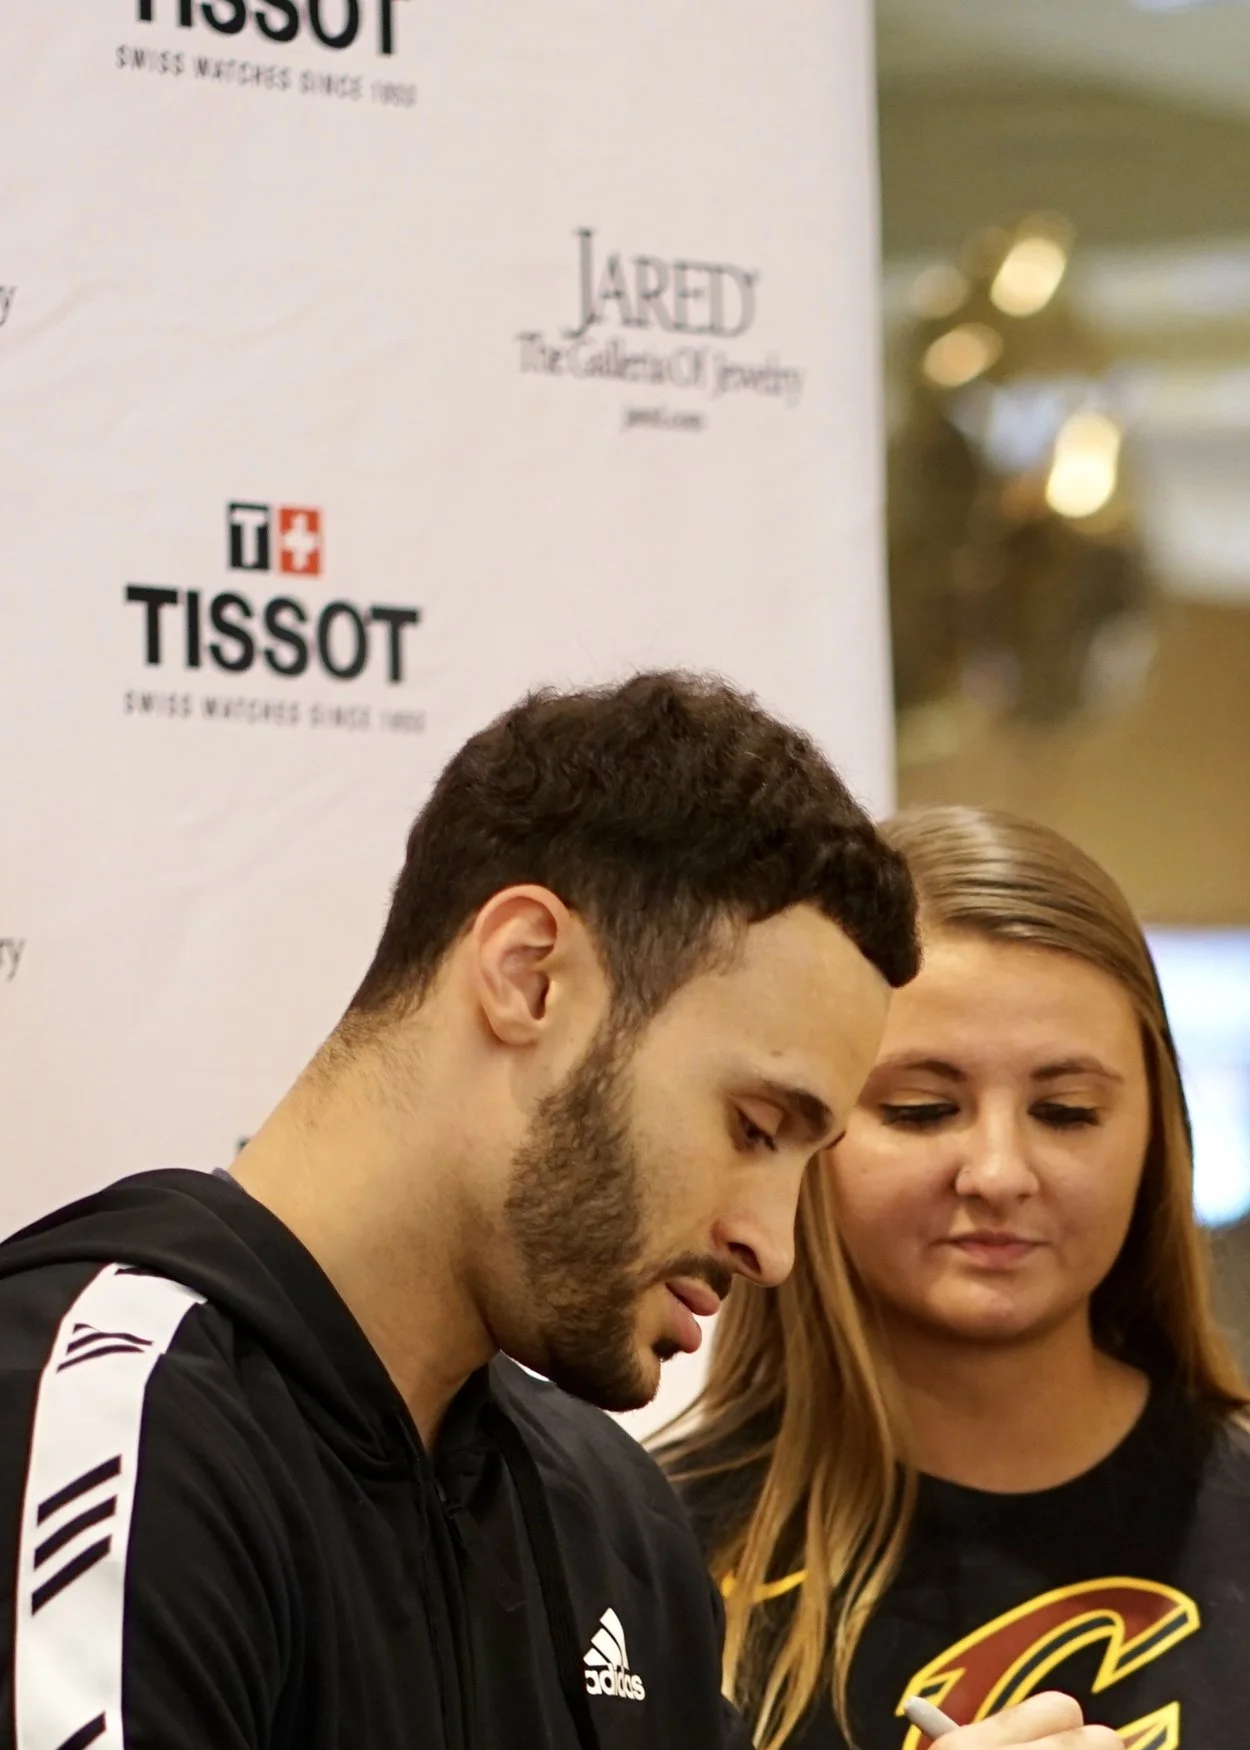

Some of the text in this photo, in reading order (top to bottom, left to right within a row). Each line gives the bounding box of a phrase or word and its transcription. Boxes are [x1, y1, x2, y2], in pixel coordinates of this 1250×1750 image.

[137, 0, 394, 54] SOT
[115, 45, 185, 76] SWISS
[191, 55, 292, 92] WATCHES
[300, 69, 365, 102] SINCE
[560, 227, 758, 338] JARED
[514, 331, 563, 375] The
[125, 585, 421, 684] TISSOT
[124, 689, 193, 718] SWISS
[202, 696, 301, 727] WATCHES
